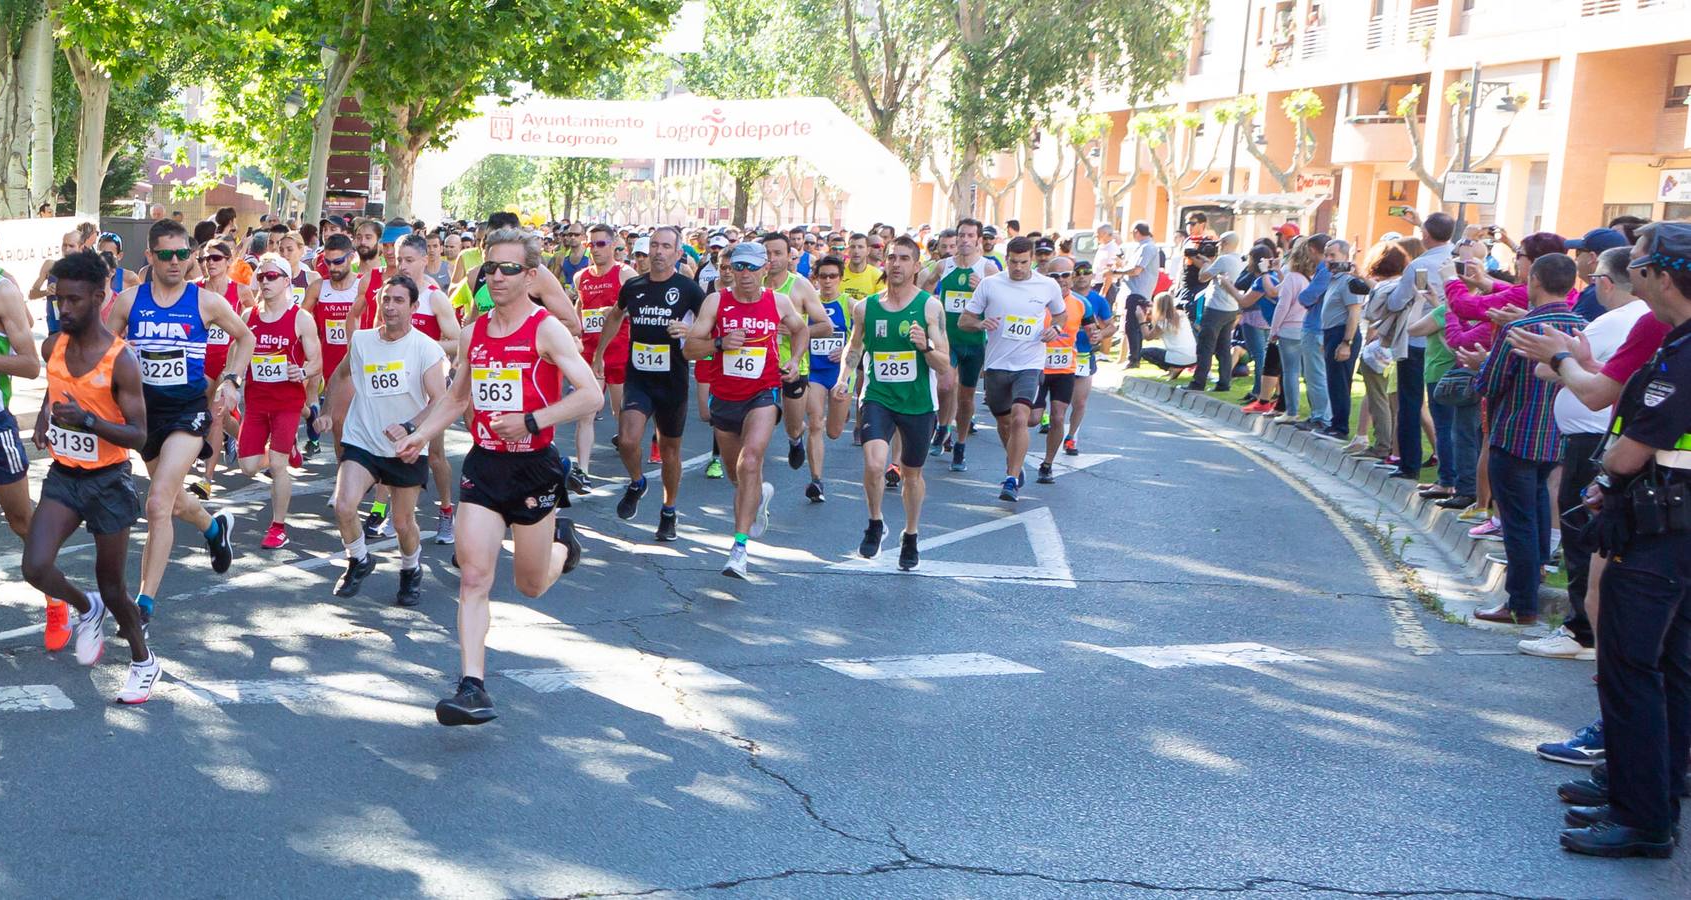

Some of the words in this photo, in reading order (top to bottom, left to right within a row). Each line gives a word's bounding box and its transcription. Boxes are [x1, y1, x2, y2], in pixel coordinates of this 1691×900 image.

[523, 113, 644, 128] Ayuntamiento
[521, 130, 541, 143] de
[638, 305, 672, 316] vintae
[586, 316, 605, 328] 260
[722, 316, 738, 328] La
[742, 317, 776, 335] Rioja
[134, 321, 190, 339] JMA
[210, 328, 224, 340] 28
[1008, 323, 1032, 336] 400
[260, 334, 290, 349] Rioja
[812, 339, 843, 351] 3179
[637, 352, 663, 365] 314
[734, 358, 754, 371] 46
[1048, 354, 1068, 365] 138
[142, 361, 184, 378] 3226
[257, 364, 281, 377] 264
[880, 362, 910, 376] 285
[371, 372, 399, 390] 668
[478, 383, 513, 402] 563
[50, 428, 95, 453] 3139
